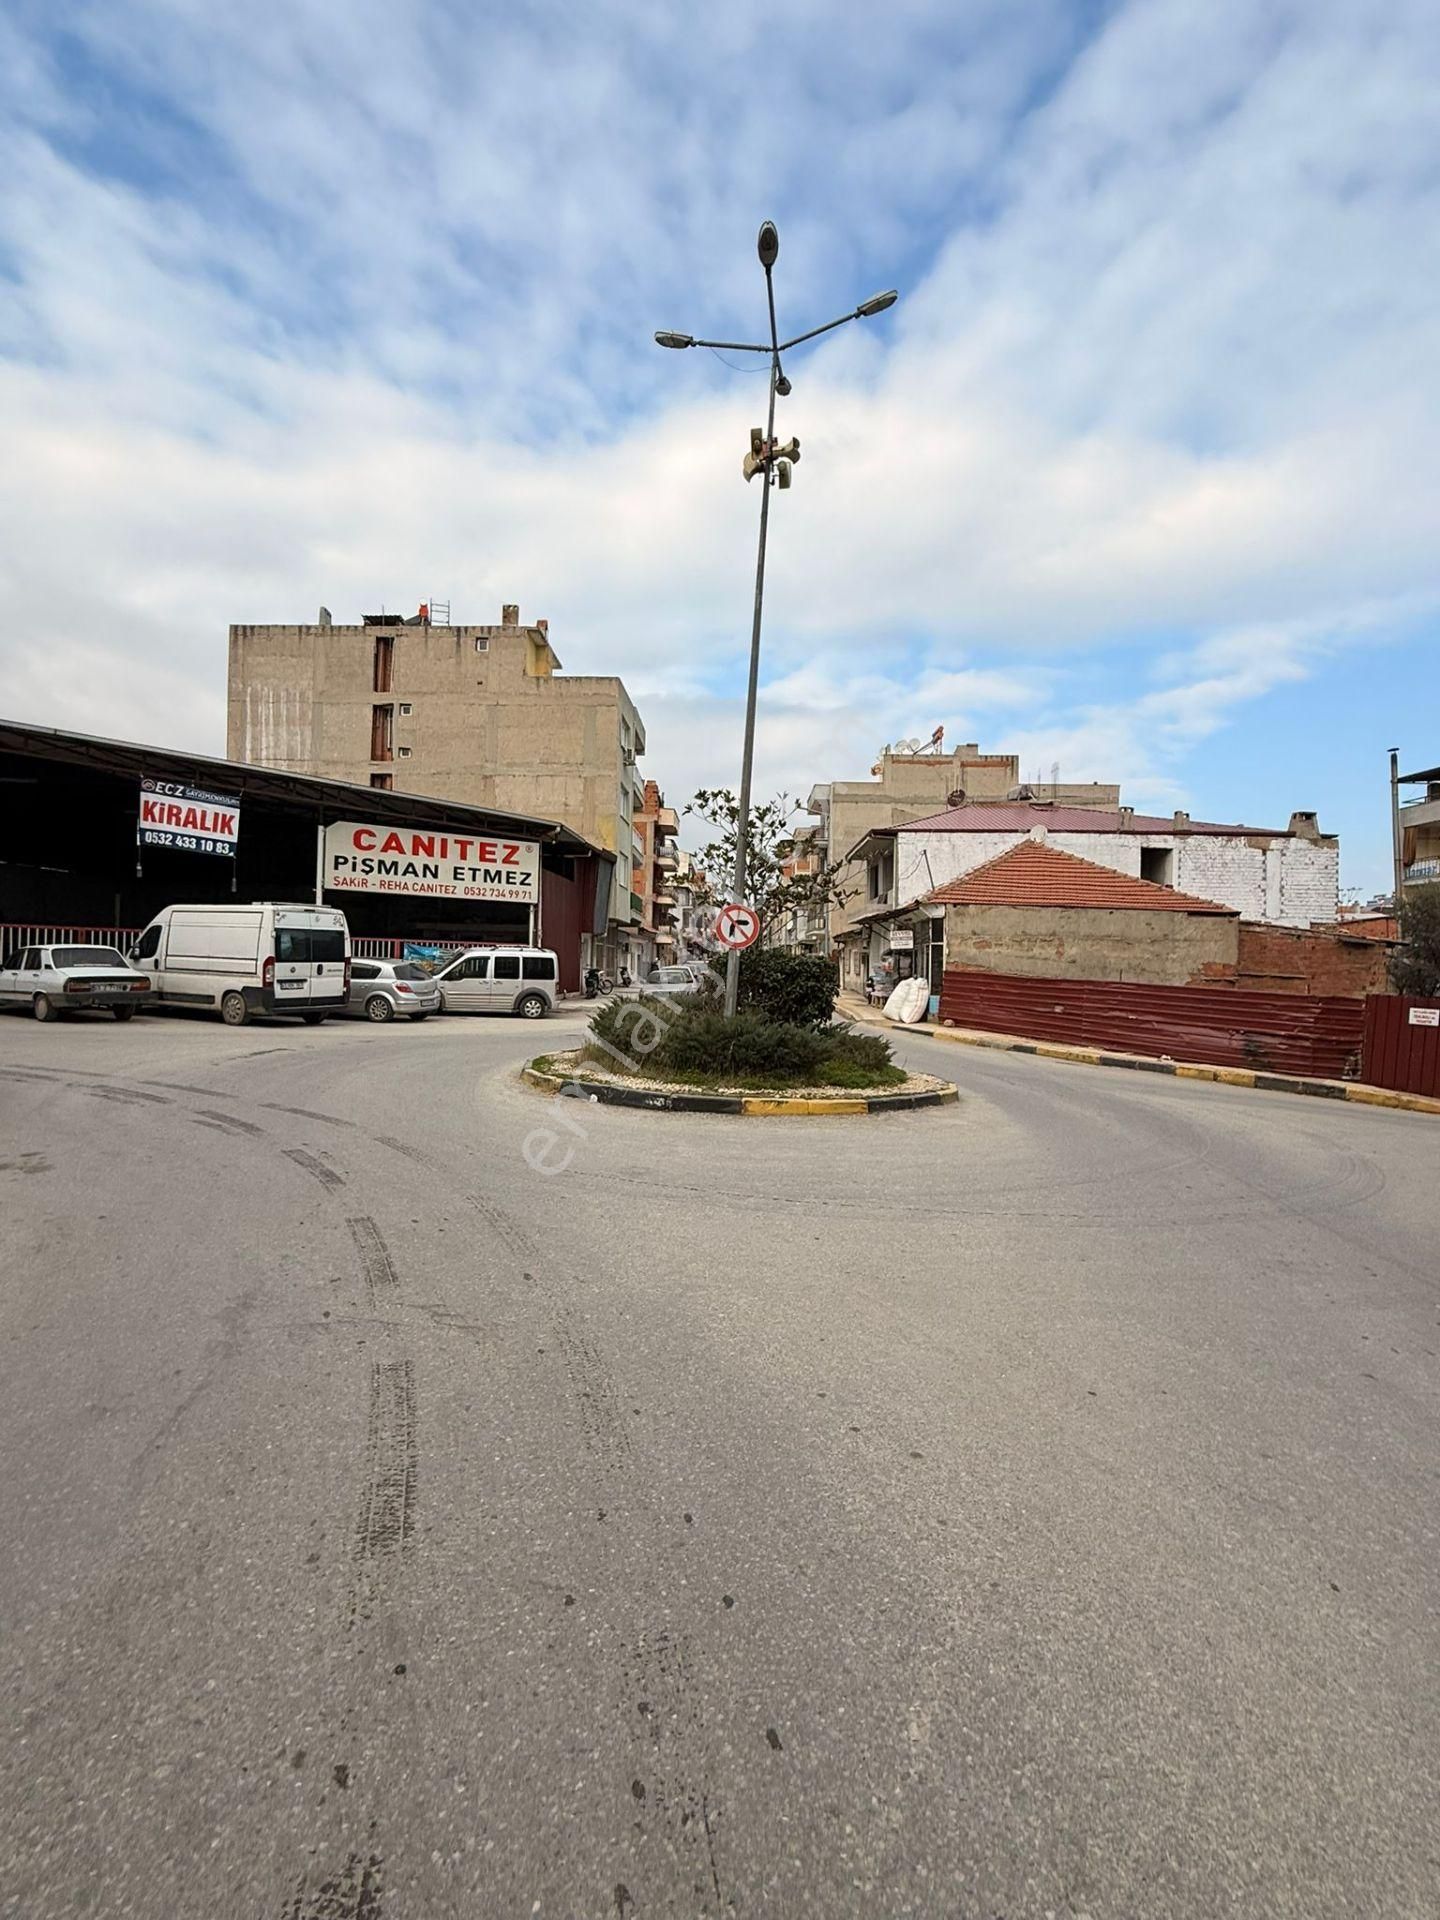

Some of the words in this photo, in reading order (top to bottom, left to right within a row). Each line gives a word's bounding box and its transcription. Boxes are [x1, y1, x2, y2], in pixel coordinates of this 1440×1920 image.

[155, 782, 184, 796] ECZ
[145, 831, 173, 845] 0532
[175, 835, 197, 849] 433
[200, 839, 213, 852] 10
[216, 842, 230, 854] 83
[353, 828, 519, 866] CANITEZ
[453, 866, 532, 886] ETMEZ
[380, 880, 409, 891] REHA
[412, 882, 457, 895] CANITEZ
[464, 886, 487, 897] 0532
[489, 888, 506, 898] 734
[508, 889, 520, 899] 99
[522, 890, 532, 900] 71
